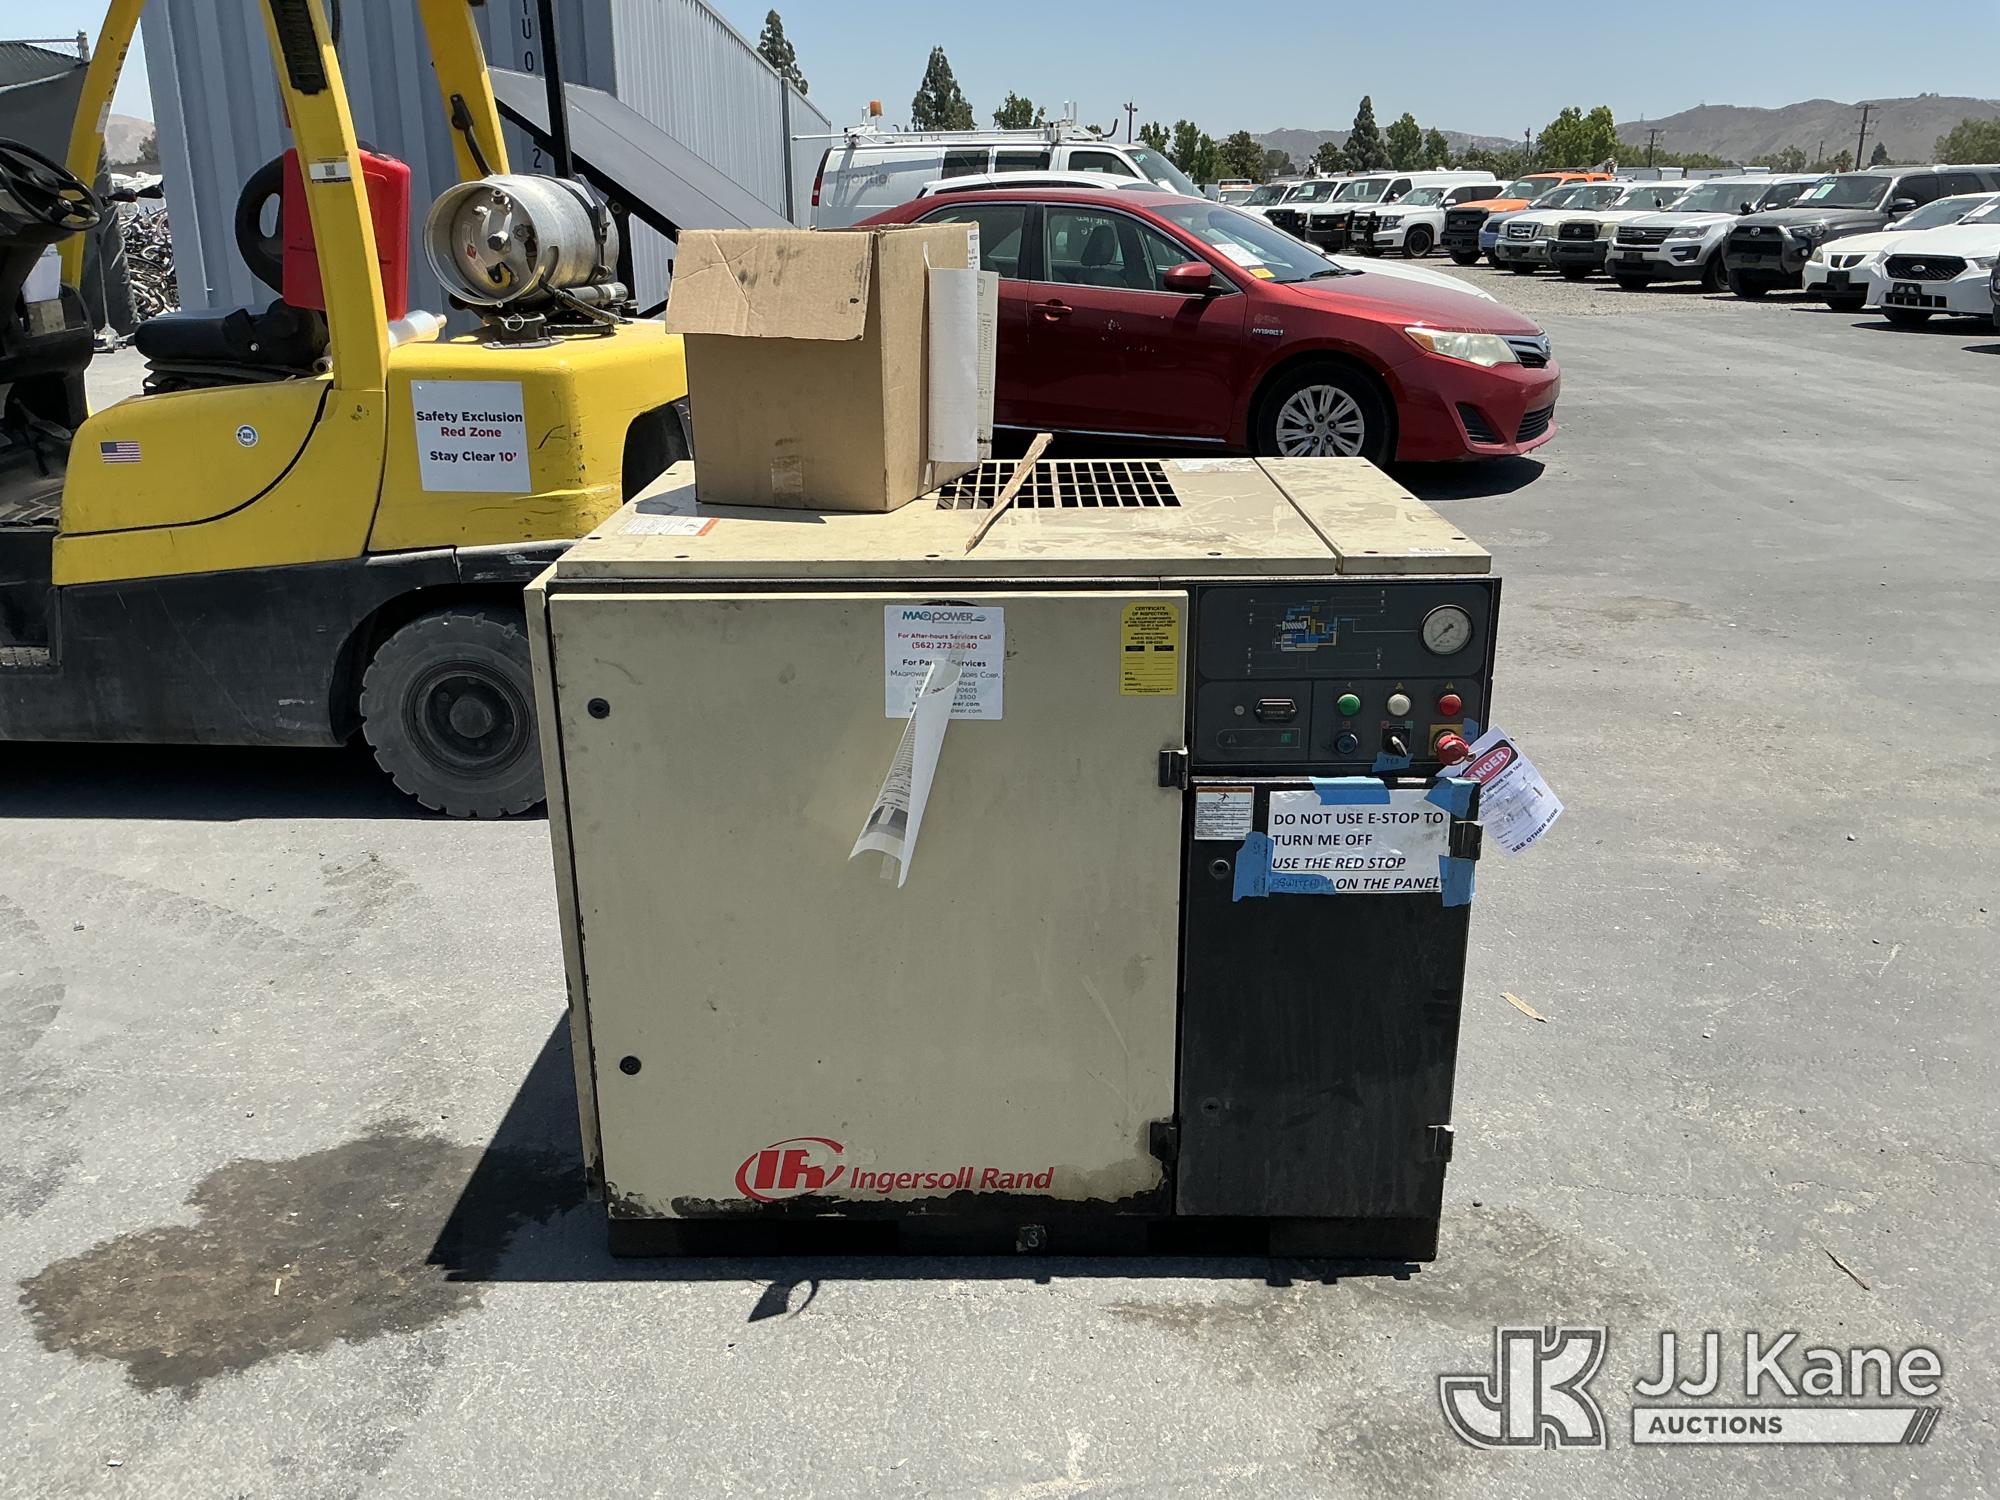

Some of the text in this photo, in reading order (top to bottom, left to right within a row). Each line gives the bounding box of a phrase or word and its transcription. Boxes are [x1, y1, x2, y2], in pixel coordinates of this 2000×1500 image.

[532, 148, 541, 168] 2
[416, 411, 523, 423] Safety Exclusion
[441, 427, 502, 437] Red Zone
[430, 451, 458, 463] Stay
[462, 451, 495, 462] Clear
[1274, 812, 1444, 825] DO NOT USE E-STOP TO
[1511, 808, 1559, 853] SEE OTHER SIDE
[1273, 834, 1373, 846] TURN ME OFF
[1272, 857, 1406, 869] USE THE RED STOP
[1336, 877, 1439, 890] ON THE PANEL
[849, 1167, 974, 1194] Ingersoll
[979, 1167, 1055, 1189] Rand
